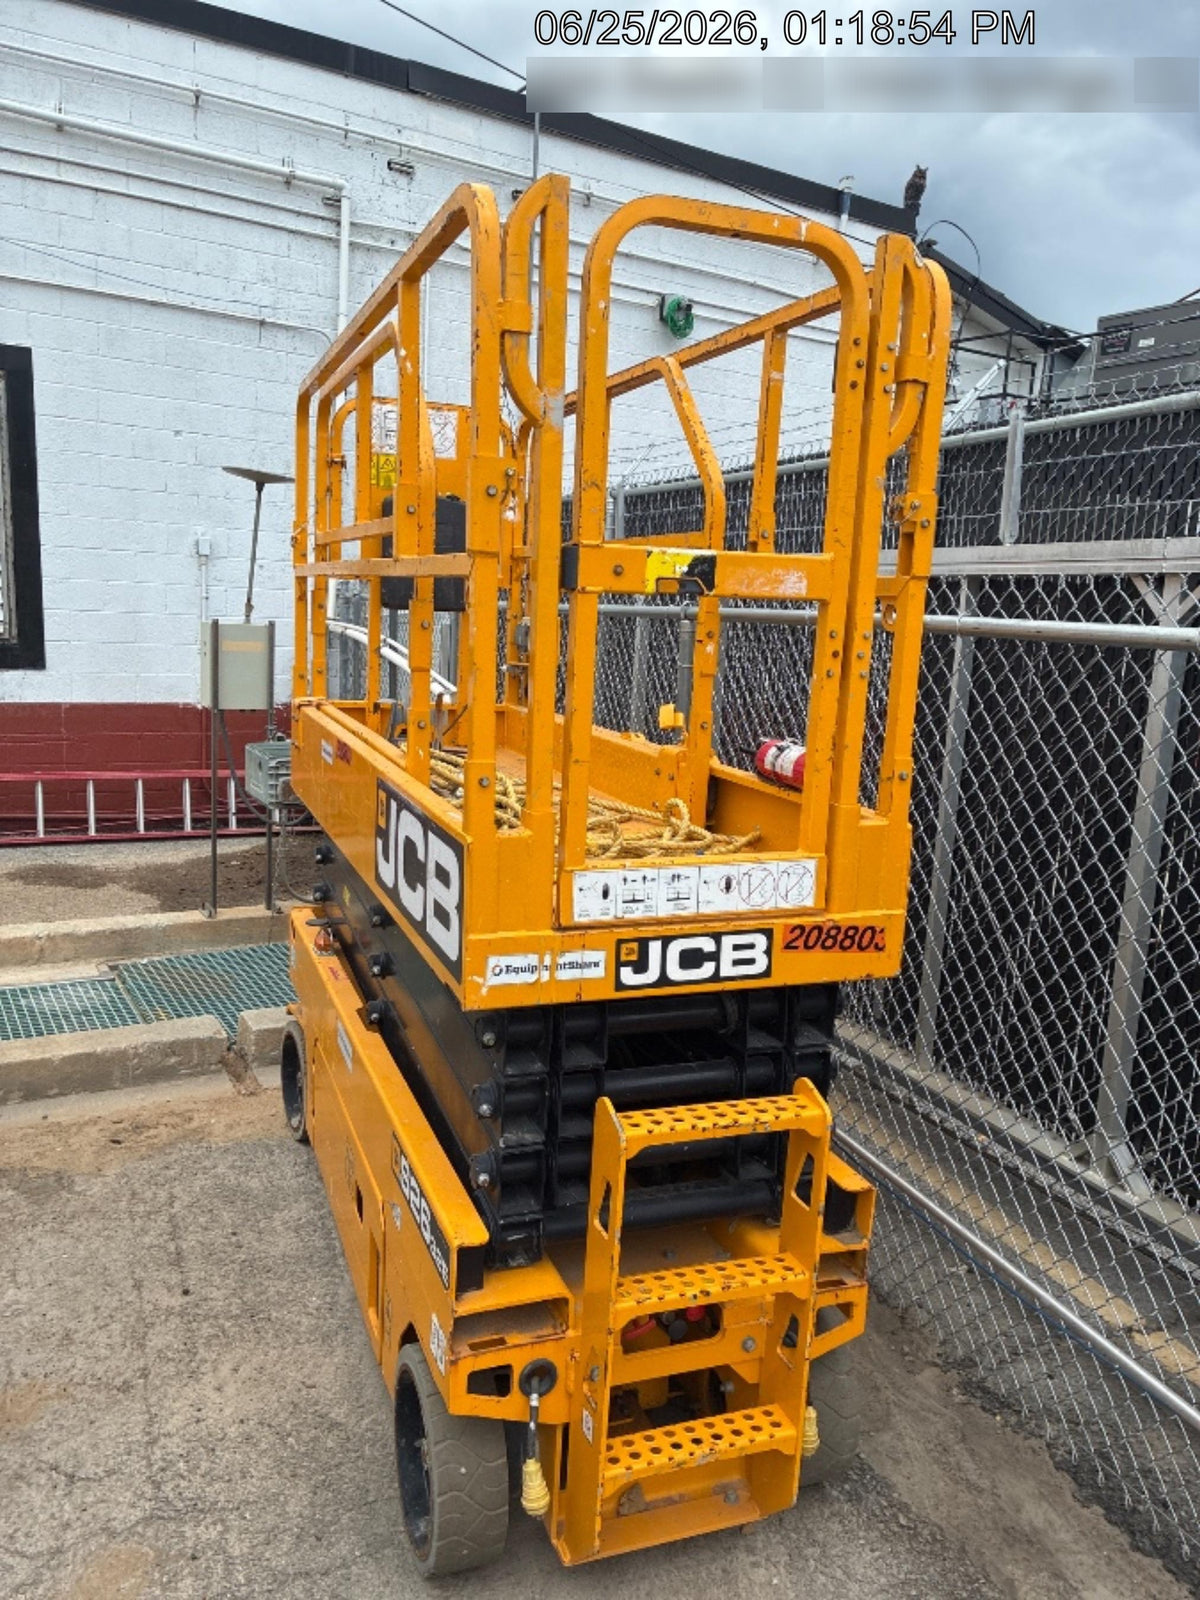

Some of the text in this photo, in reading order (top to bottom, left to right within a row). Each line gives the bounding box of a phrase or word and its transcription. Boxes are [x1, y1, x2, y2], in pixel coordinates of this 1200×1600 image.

[377, 797, 460, 962] JCB
[504, 960, 601, 976] EquipntShare
[619, 932, 769, 986] JCB
